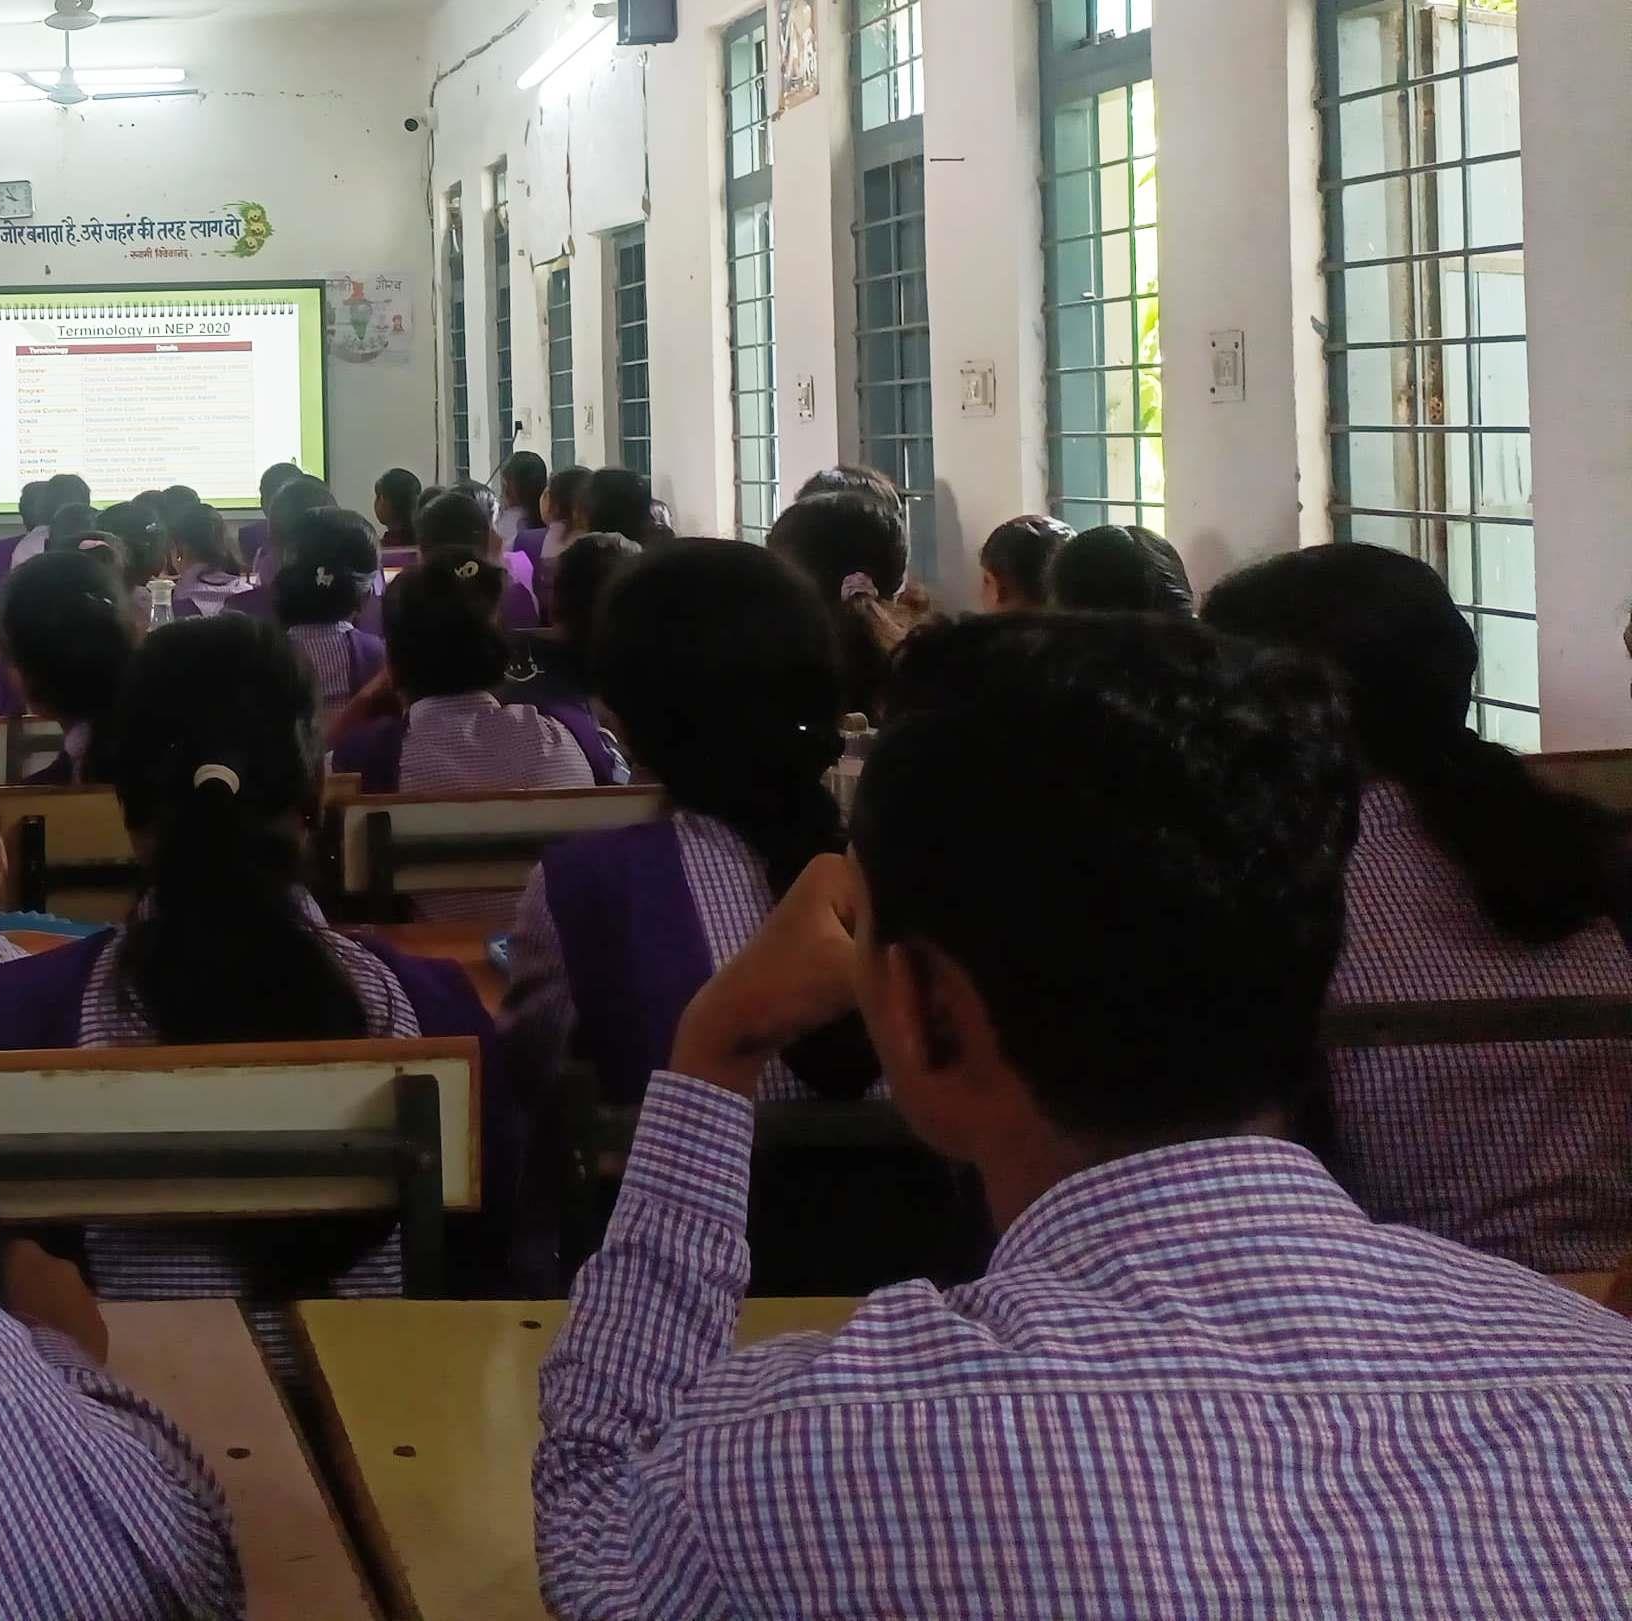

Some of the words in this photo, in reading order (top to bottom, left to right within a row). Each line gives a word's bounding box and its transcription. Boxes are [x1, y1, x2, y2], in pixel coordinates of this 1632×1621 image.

[27, 225, 63, 245] बनाता
[81, 217, 104, 243] उसे
[138, 217, 155, 239] की
[157, 220, 186, 241] तरह
[189, 219, 222, 239] त्याग
[225, 214, 242, 239] दो
[57, 325, 143, 337] Terminology
[148, 325, 160, 334] in
[165, 323, 194, 335] NEP
[199, 322, 231, 334] 2020
